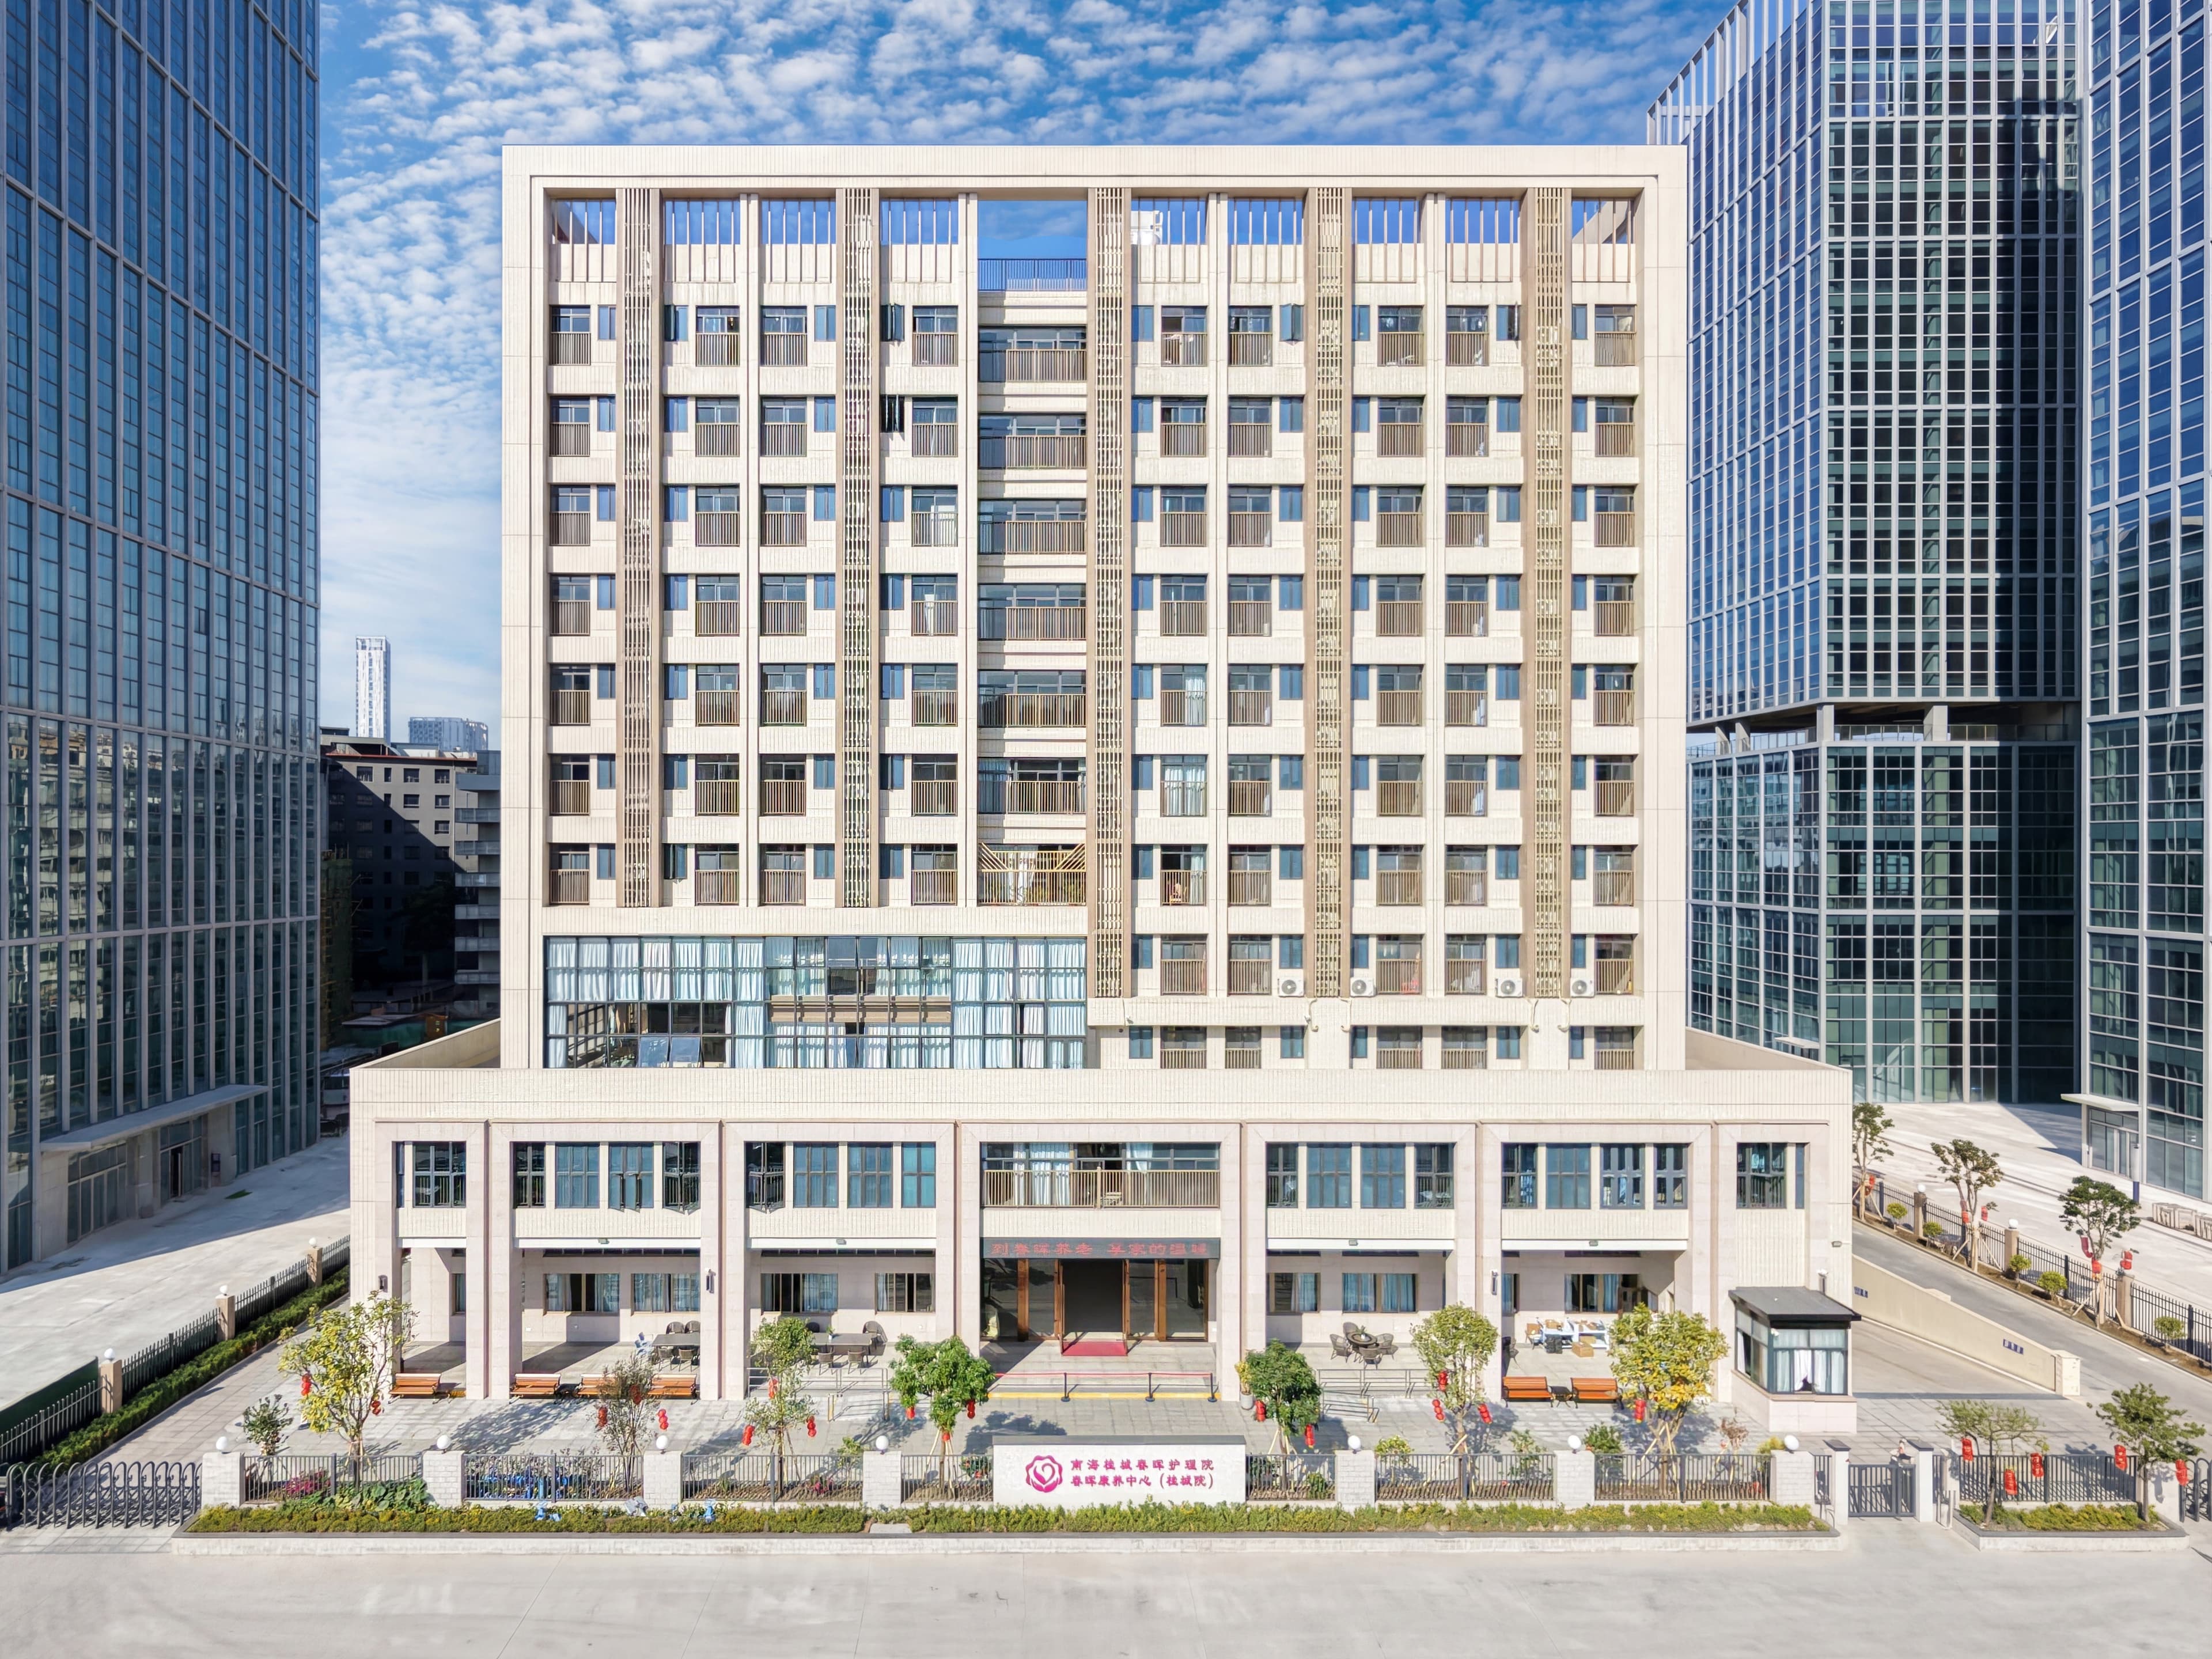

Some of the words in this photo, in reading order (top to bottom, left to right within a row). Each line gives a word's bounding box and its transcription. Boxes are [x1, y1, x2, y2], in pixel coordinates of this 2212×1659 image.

[1071, 1459, 1214, 1471] 南海桂城春晖护理院
